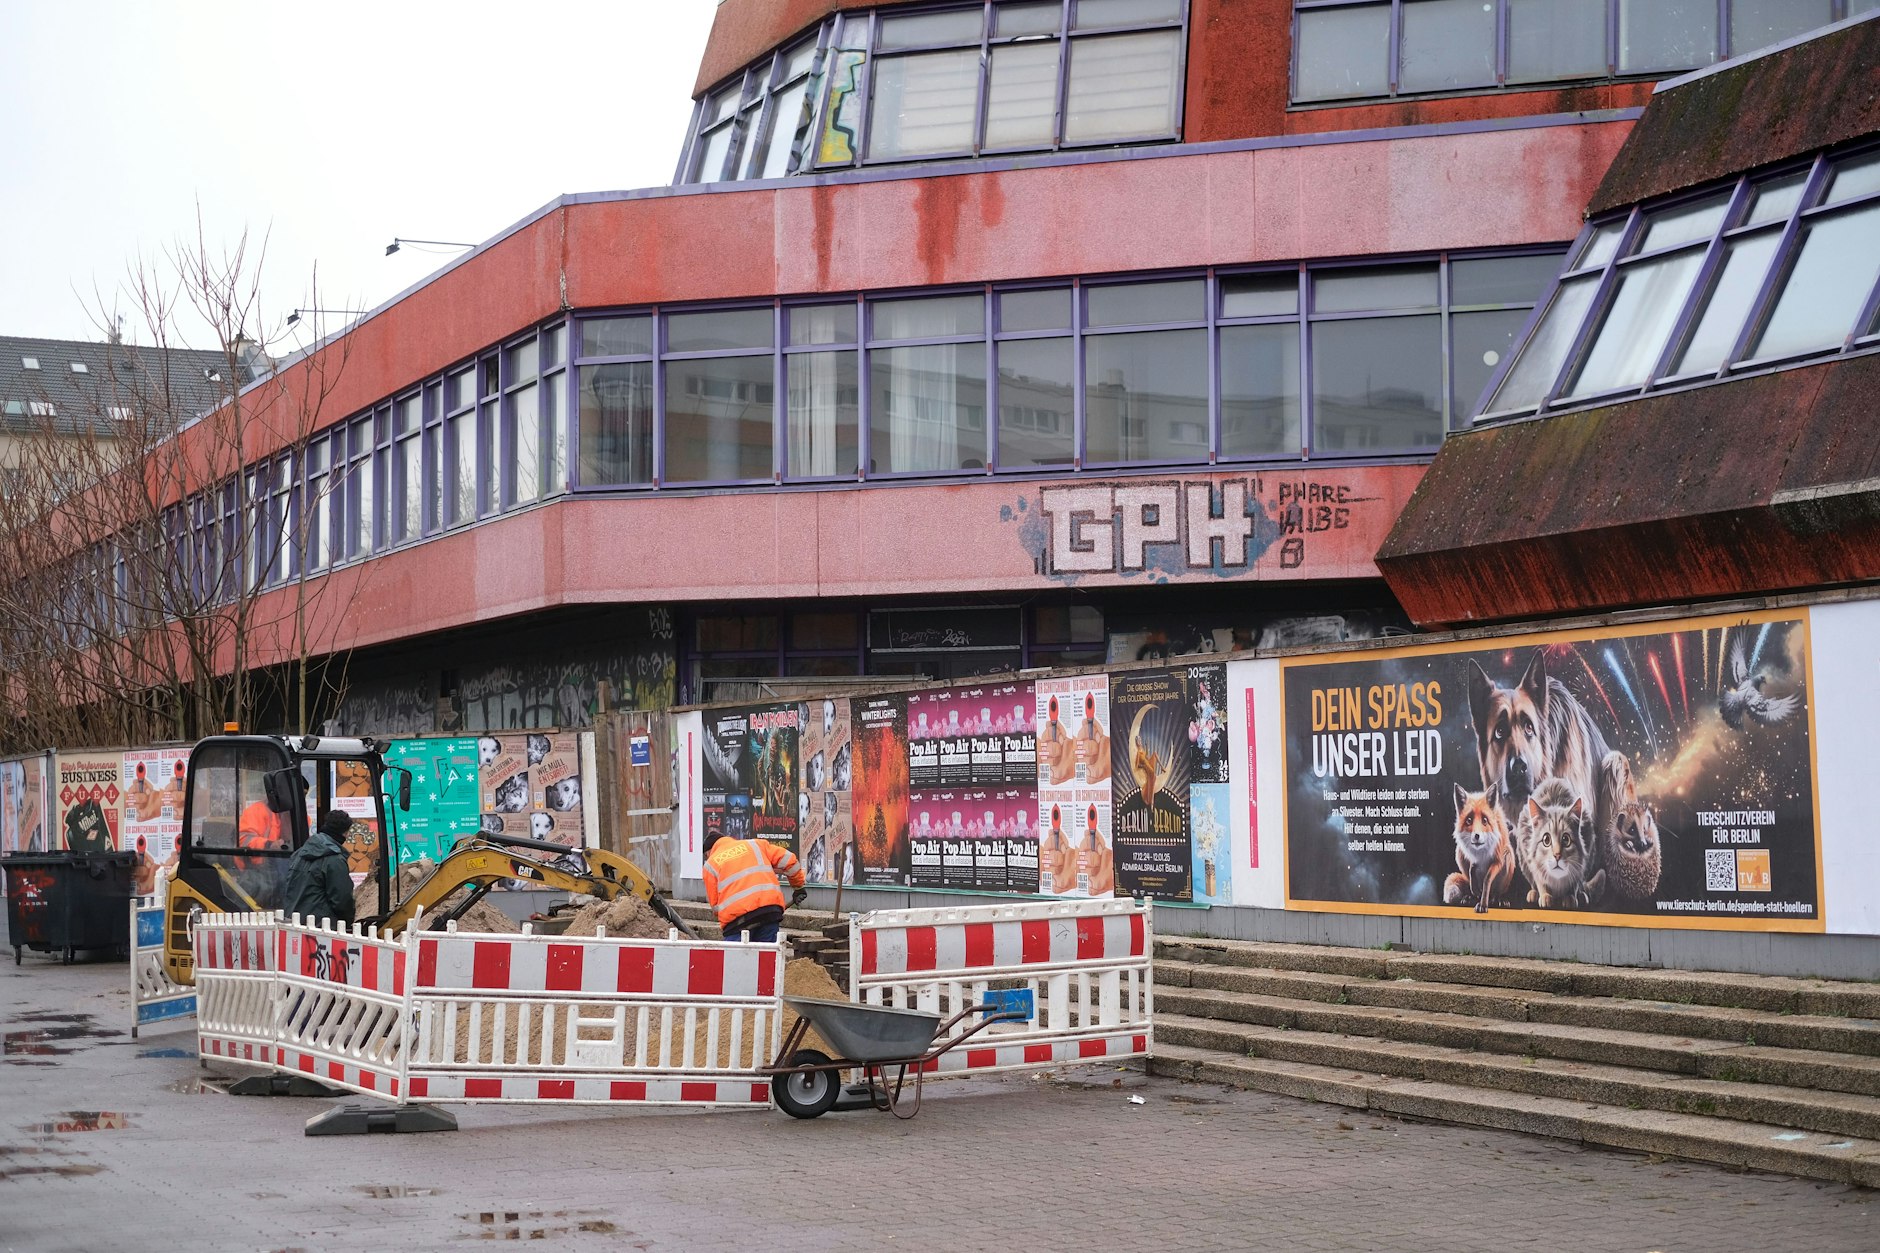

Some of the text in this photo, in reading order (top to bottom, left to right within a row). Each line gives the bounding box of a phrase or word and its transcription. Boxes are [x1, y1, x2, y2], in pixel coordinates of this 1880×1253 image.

[1040, 479, 1254, 576] GPH
[1312, 681, 1442, 731] DEIN SPASS
[750, 713, 769, 734] IRON
[769, 710, 799, 732] MAIDEN
[861, 709, 897, 721] WINTERLIGHTS
[910, 740, 938, 757] Pop Air
[940, 739, 970, 756] Pop Air
[971, 737, 1002, 753] Pop Air
[1004, 735, 1036, 751] Pop Air
[1313, 729, 1442, 777] UNSER LEID
[61, 761, 117, 772] High Performance
[536, 758, 566, 776] WIE MÜLL
[1219, 760, 1228, 770] 24
[61, 770, 118, 784] BUSINESS
[538, 765, 570, 785] ENTSORGT!
[1219, 771, 1228, 781] 25
[1323, 788, 1430, 801] Haus- und Wildtiere leiden oder sterben
[1331, 805, 1421, 817] an Silvester. Mach Schluss damit.
[1696, 811, 1776, 826] TIERSCHUTZVEREIN
[1121, 808, 1182, 834] BERLIN BERLIN
[1344, 822, 1409, 836] Hilf denen, die sich nicht
[1712, 827, 1760, 843] FÜR BERLIN
[911, 840, 941, 854] Pop Air
[943, 840, 973, 855] Pop Air
[975, 840, 1006, 856] Pop Air
[1007, 840, 1038, 856] Pop Air
[1347, 839, 1406, 852] selber helfen können.
[517, 865, 534, 877] CAT
[1121, 862, 1184, 873] ADMIRALSPALAST BERLIN
[1656, 899, 1813, 914] www.tierschutz-berlin.de/spenden-statt-boellern
